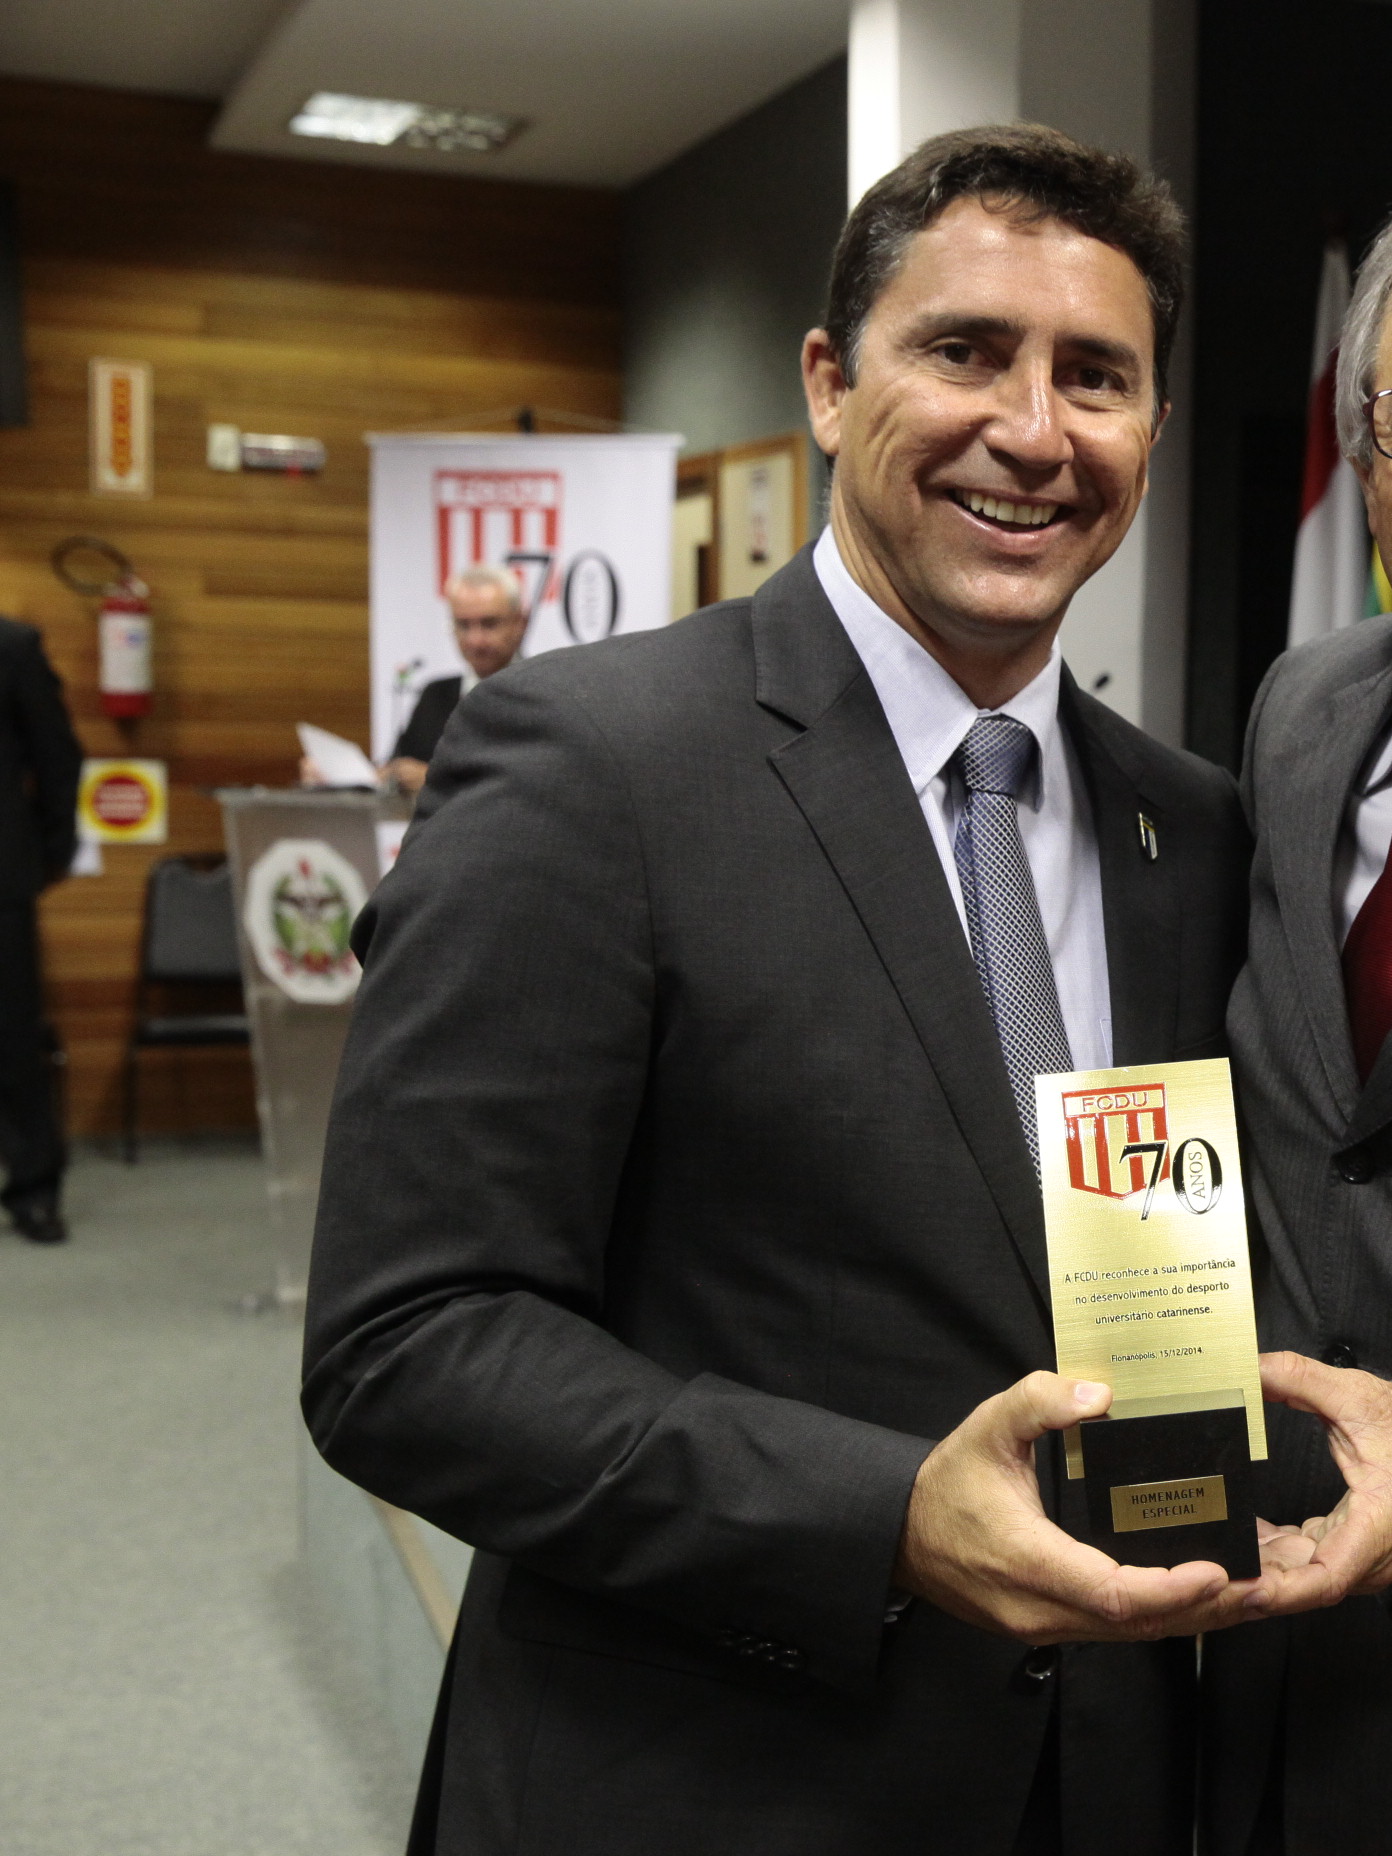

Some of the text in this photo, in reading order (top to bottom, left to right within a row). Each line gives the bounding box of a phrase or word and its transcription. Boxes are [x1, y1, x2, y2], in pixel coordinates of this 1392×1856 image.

[505, 547, 620, 652] 70
[1082, 1091, 1148, 1112] FCDU
[1119, 1137, 1223, 1221] 70
[1188, 1151, 1206, 1199] ANOS
[1064, 1258, 1236, 1283] A FCDU reconhece a sua importância
[1075, 1281, 1230, 1305] no desenvolvimento do desporto
[1095, 1305, 1213, 1325] universitário catarinense.
[1131, 1487, 1205, 1505] HOMENAGEM
[1142, 1504, 1198, 1519] ESPECIAL
